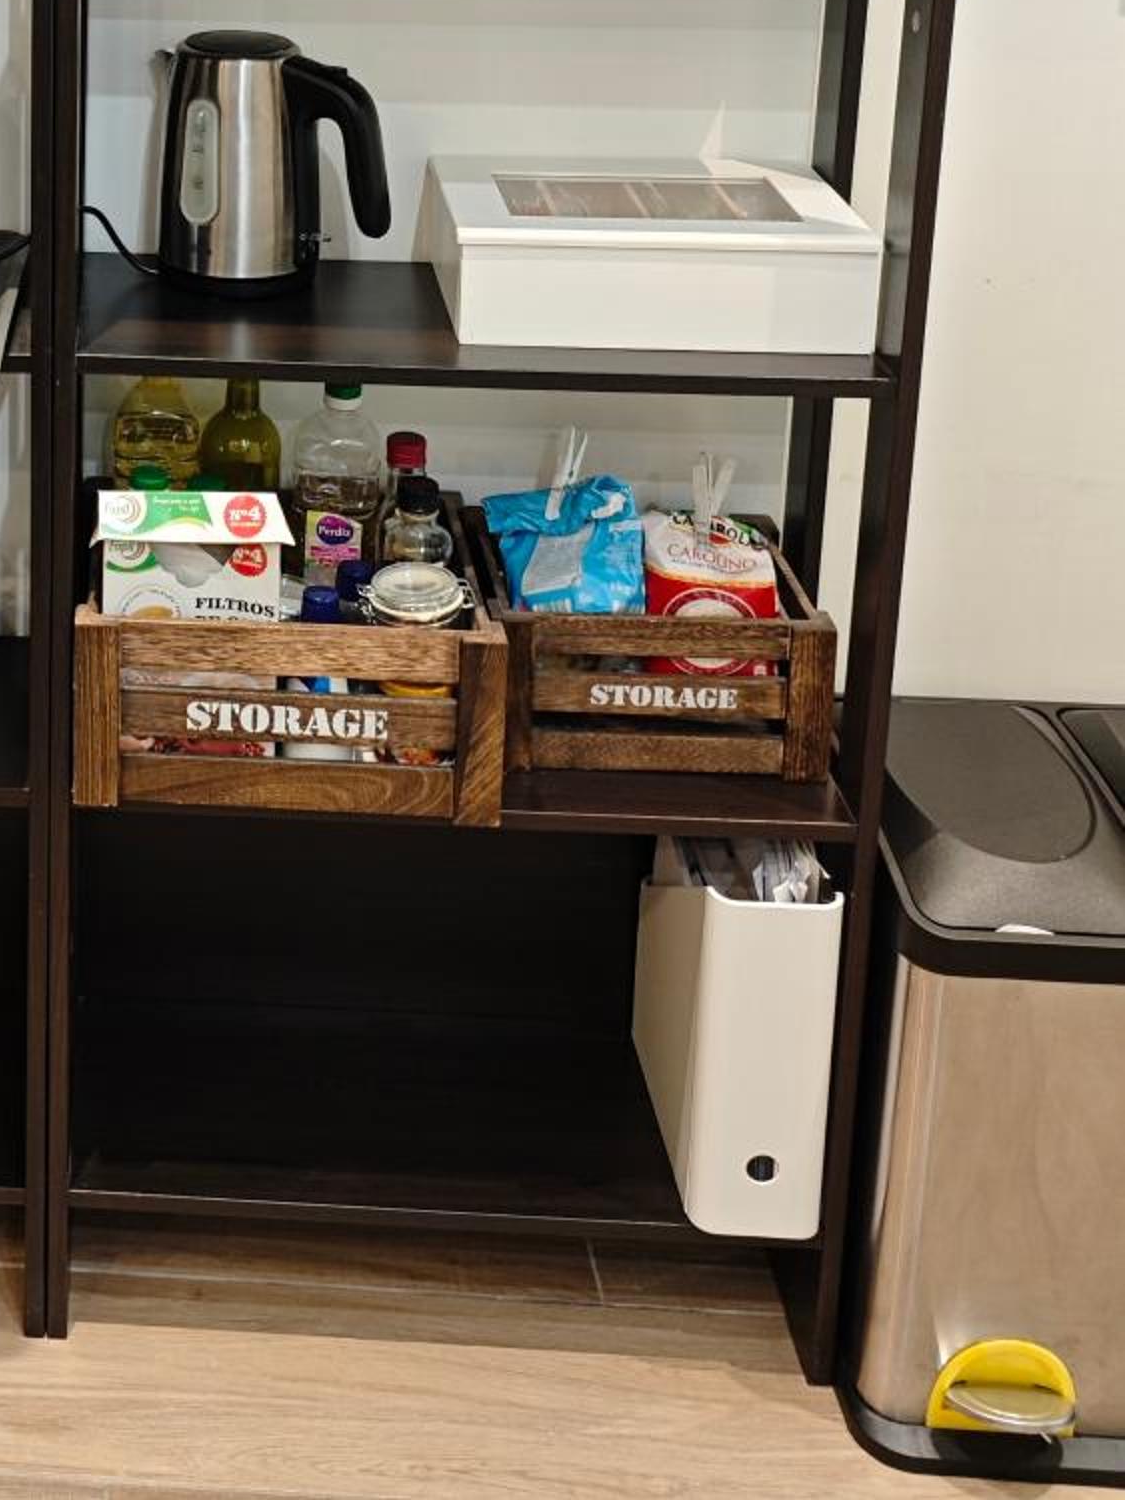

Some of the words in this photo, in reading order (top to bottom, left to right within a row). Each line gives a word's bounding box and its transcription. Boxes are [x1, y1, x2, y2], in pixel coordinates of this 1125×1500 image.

[194, 596, 275, 618] FILTROS
[589, 683, 738, 709] STORAGE
[186, 700, 389, 740] STORAGE
